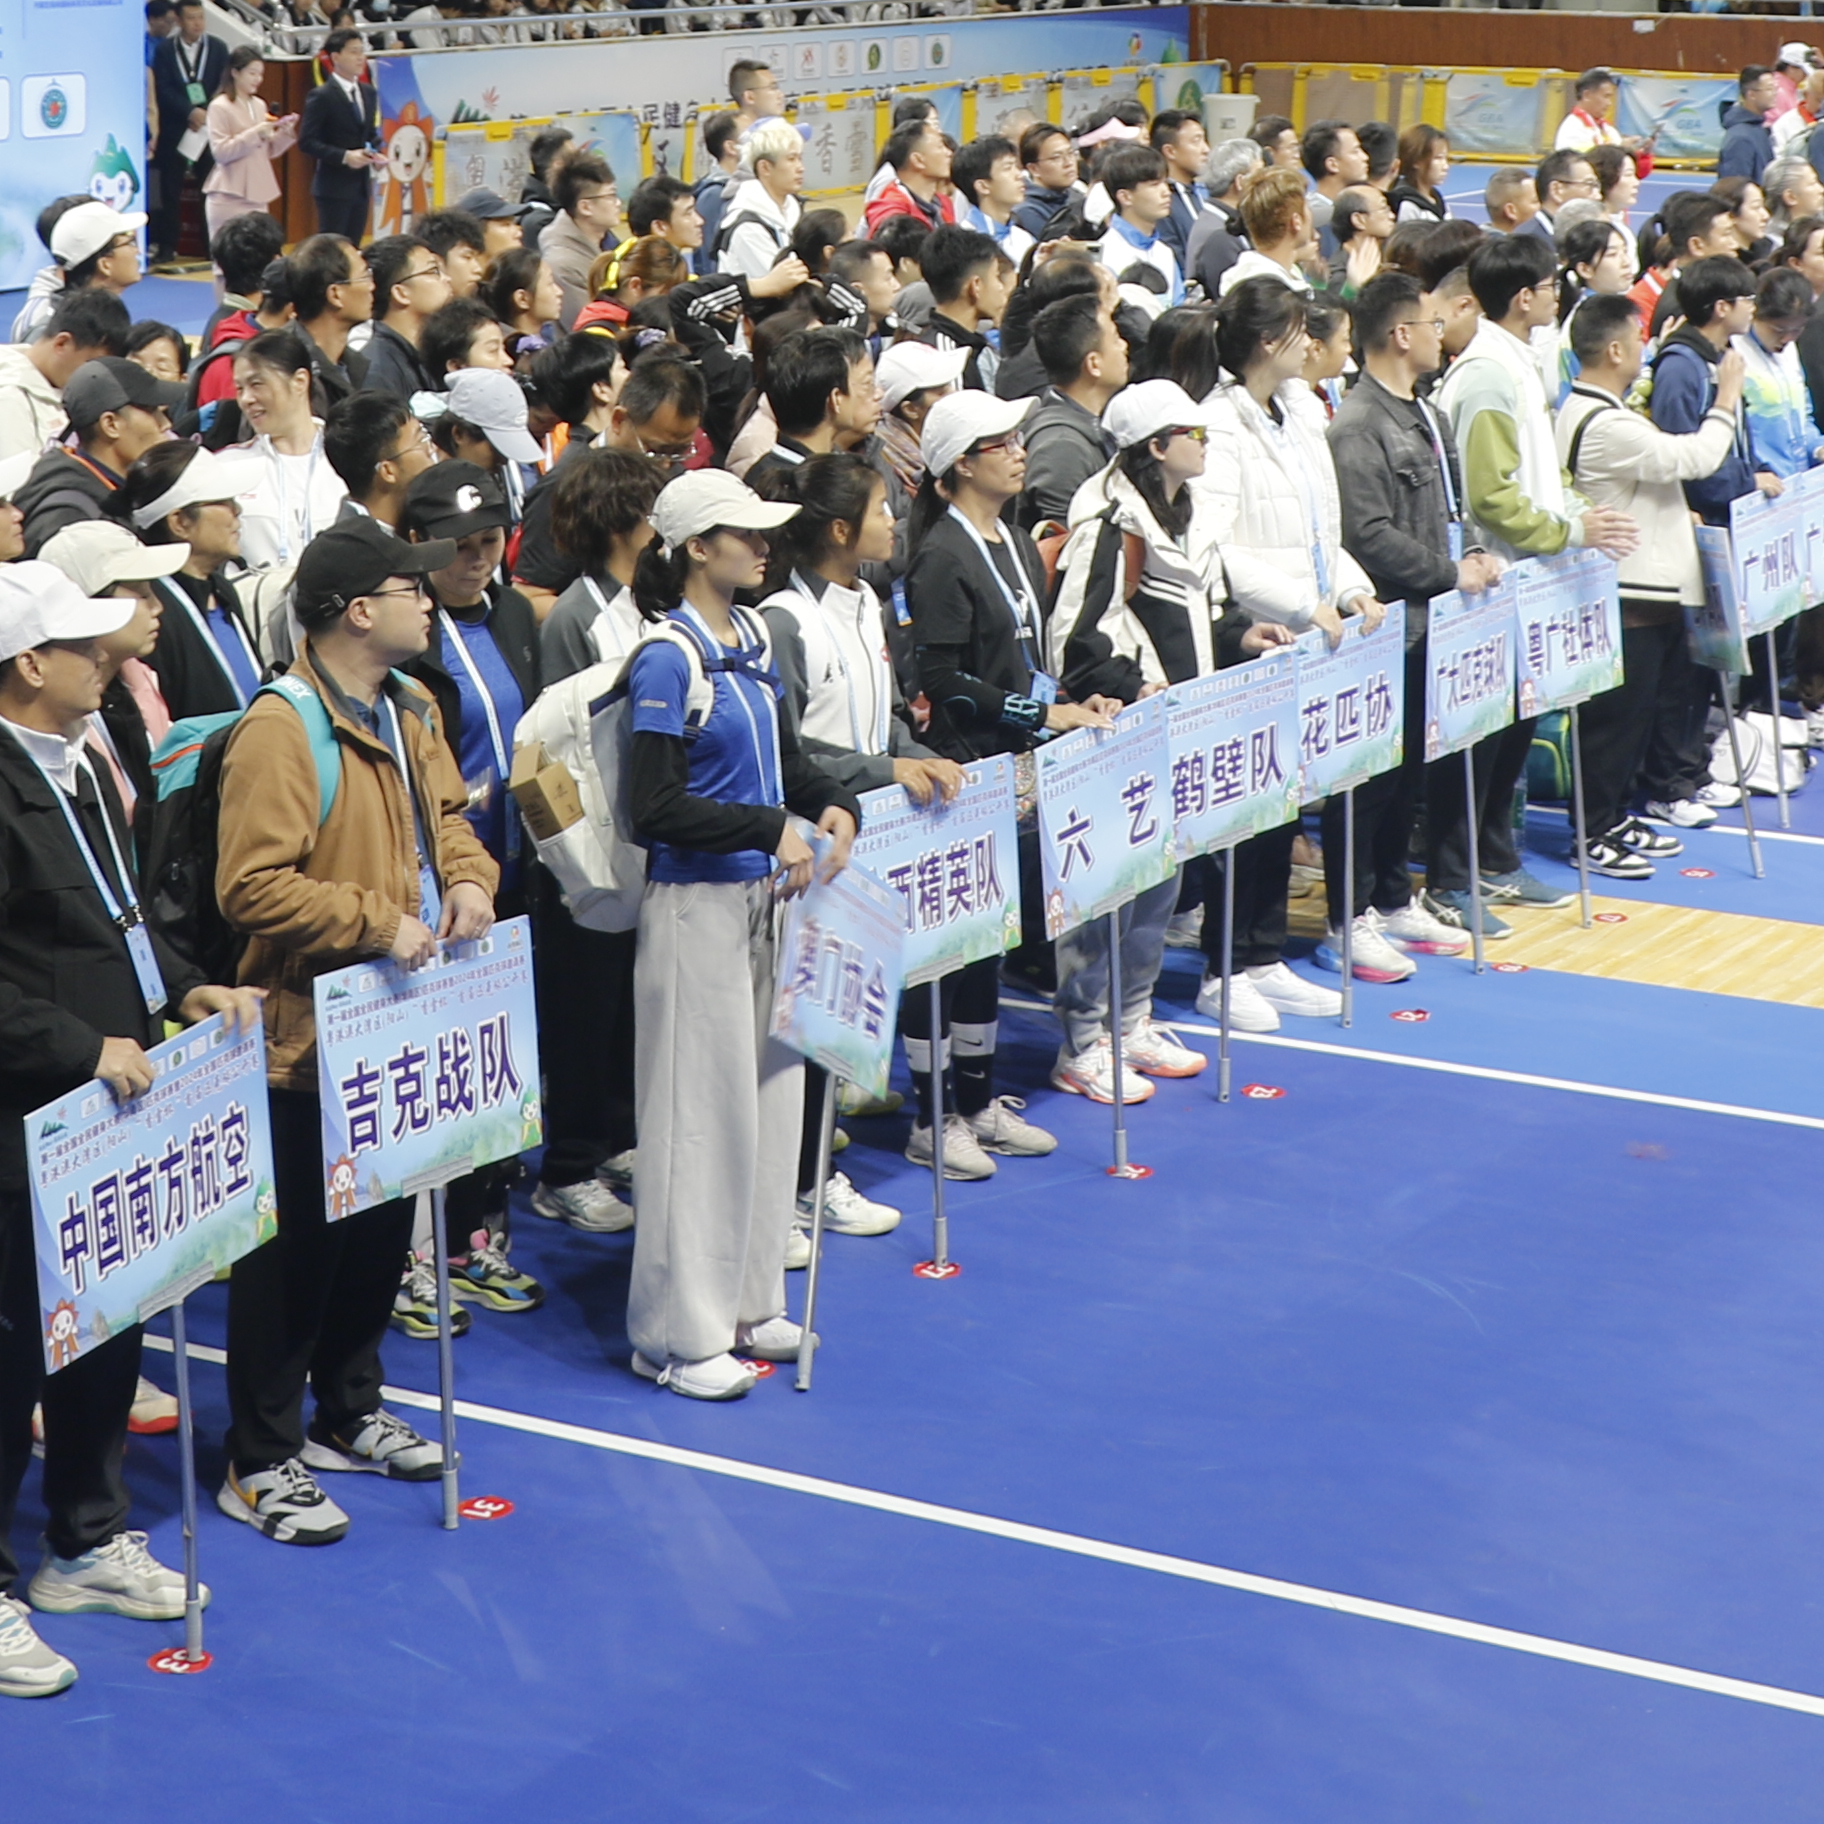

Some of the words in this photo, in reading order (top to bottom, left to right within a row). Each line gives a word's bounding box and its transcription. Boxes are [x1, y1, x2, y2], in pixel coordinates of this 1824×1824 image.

[1300, 669, 1395, 764] 花匹协
[1172, 721, 1287, 824] 鹤壁队
[869, 829, 1003, 935] 西精英队
[339, 1010, 521, 1157] 吉克战队
[57, 1101, 253, 1295] 中国南方航空
[461, 1498, 506, 1519] 31
